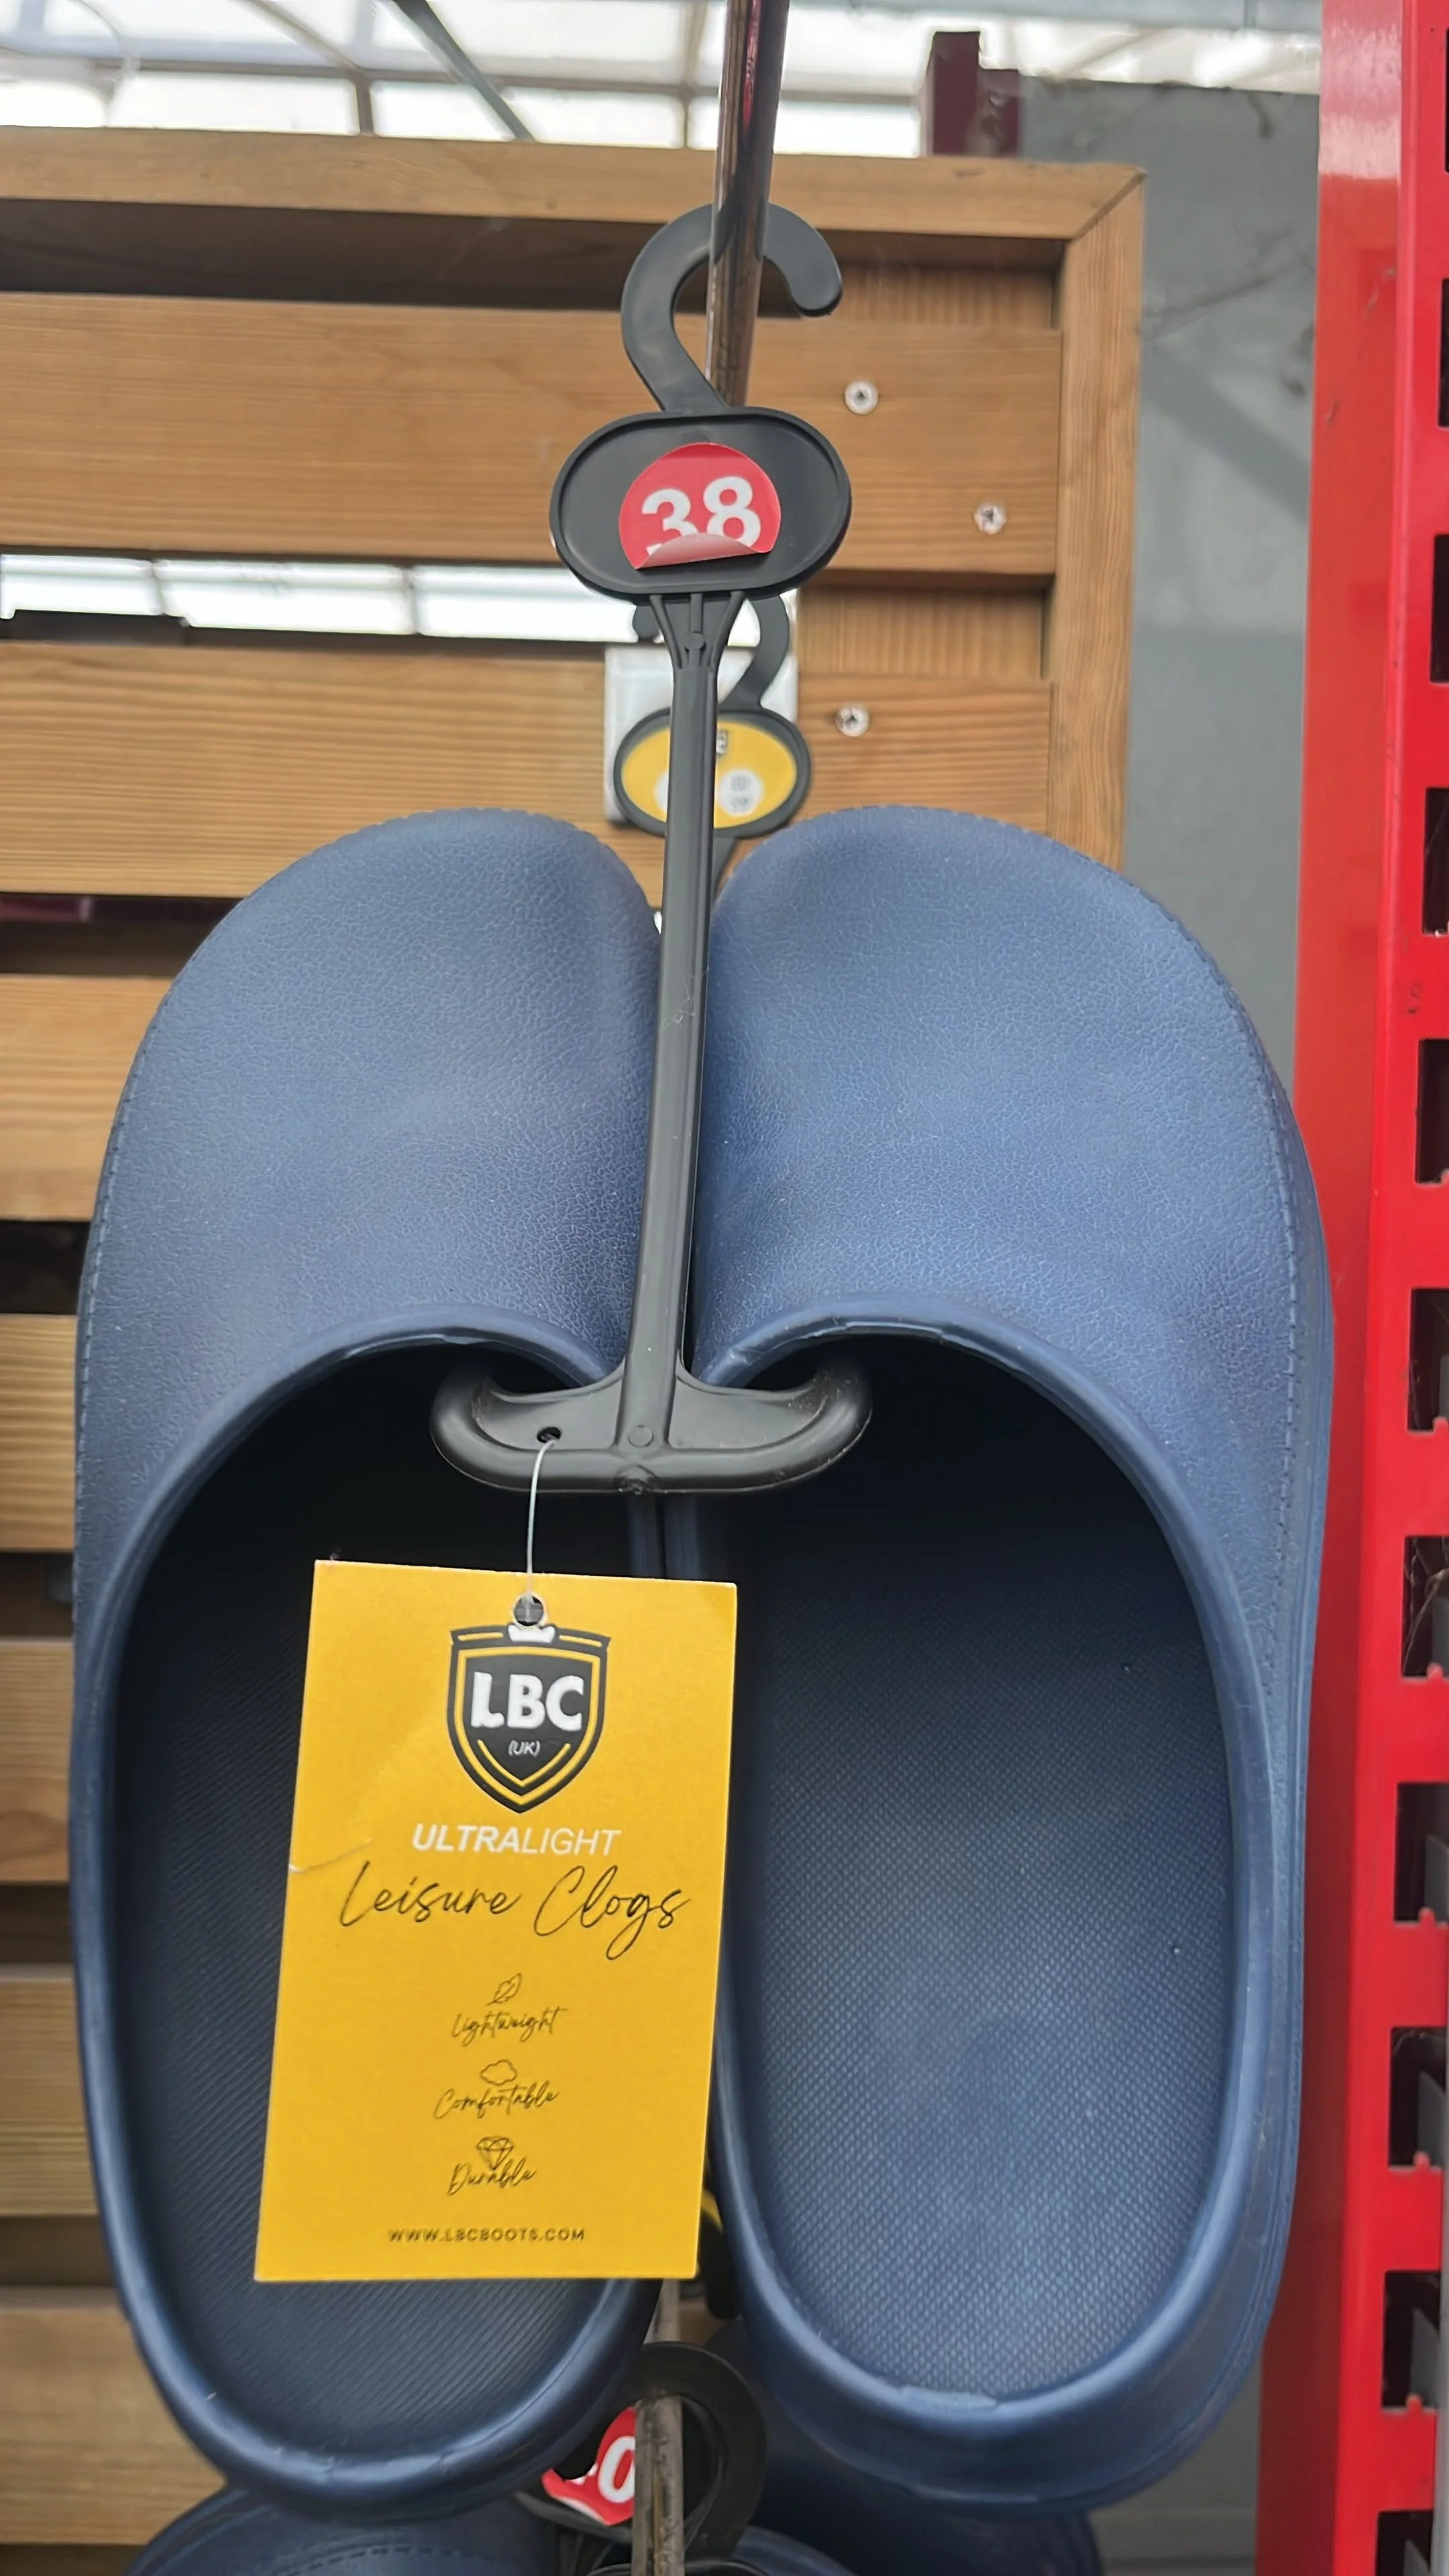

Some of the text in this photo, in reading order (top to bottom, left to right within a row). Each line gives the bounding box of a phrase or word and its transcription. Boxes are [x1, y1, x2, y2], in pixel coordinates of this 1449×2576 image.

[471, 1671, 584, 1731] LBC
[508, 1740, 541, 1757] (UK)
[413, 1824, 621, 1856] ULTRALIGHT
[339, 1860, 691, 1960] Leisure Clogs
[451, 2006, 568, 2047] Lightweight
[433, 2080, 559, 2120] Comfortable
[447, 2157, 537, 2196] Durable
[388, 2226, 586, 2243] WWW.LBCBOOTS.COM
